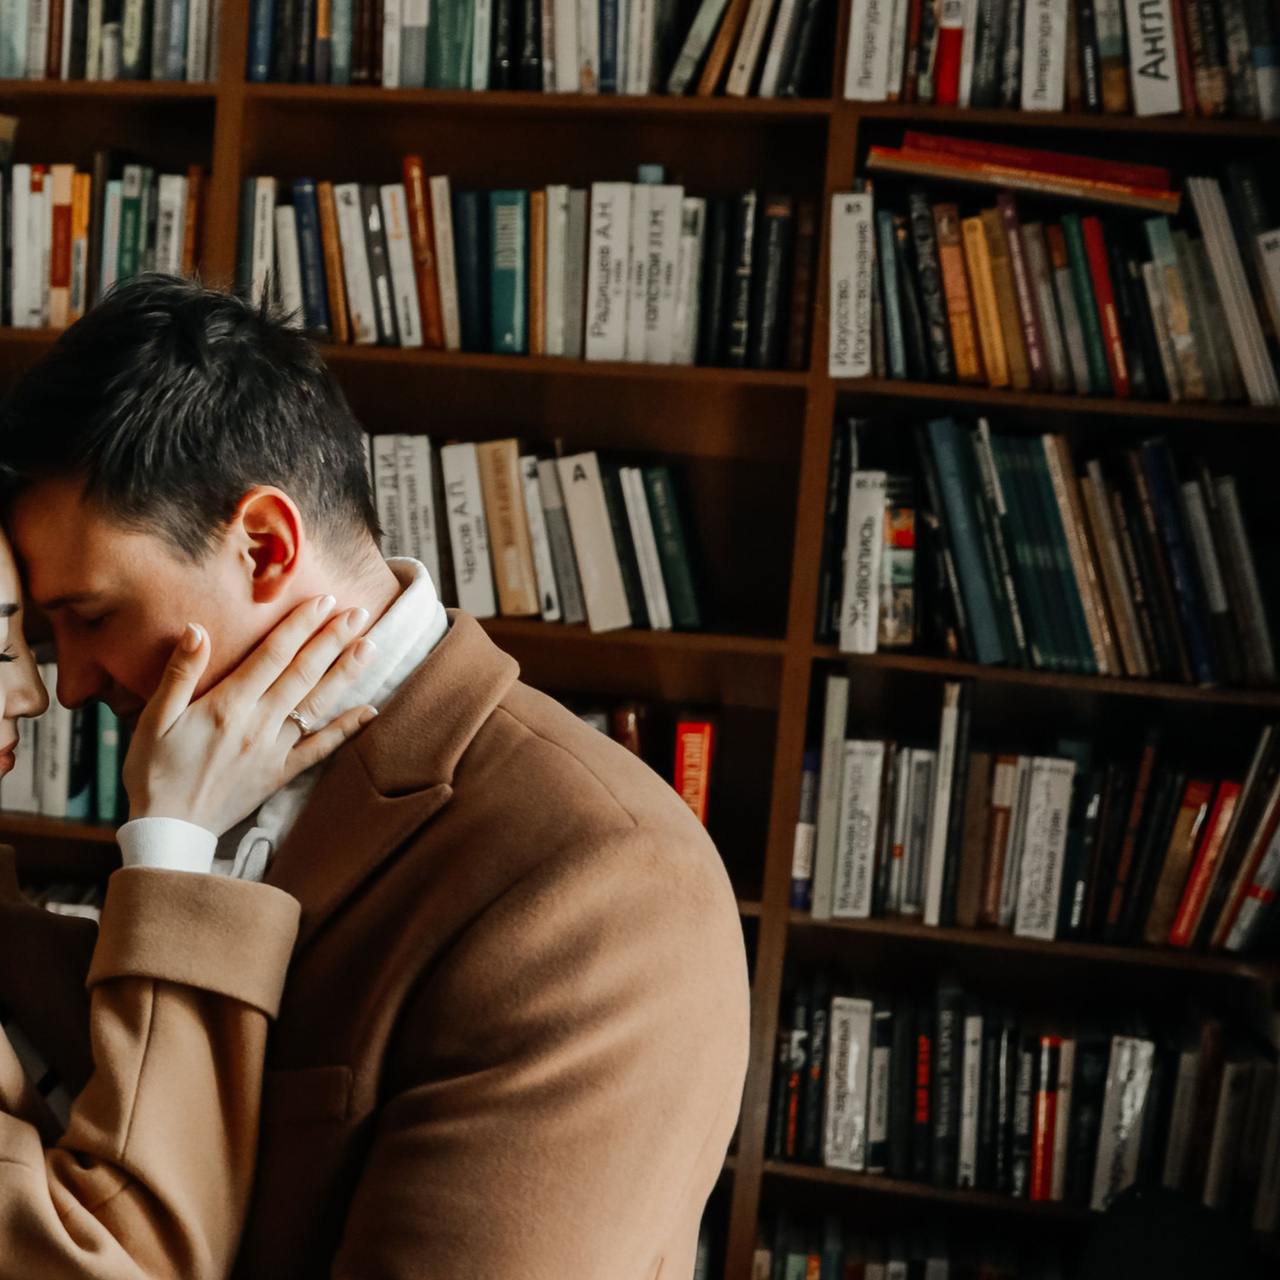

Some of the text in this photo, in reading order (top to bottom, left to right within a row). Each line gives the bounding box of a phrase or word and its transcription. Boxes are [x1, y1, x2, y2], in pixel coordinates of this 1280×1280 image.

[1032, 12, 1052, 102] Литература
[591, 244, 611, 339] Радищев
[645, 251, 662, 332] Толстой
[852, 219, 869, 368] Искусствознание
[455, 524, 477, 584] Чехов
[847, 516, 874, 628] Живопись
[838, 822, 857, 911] Музыкальная
